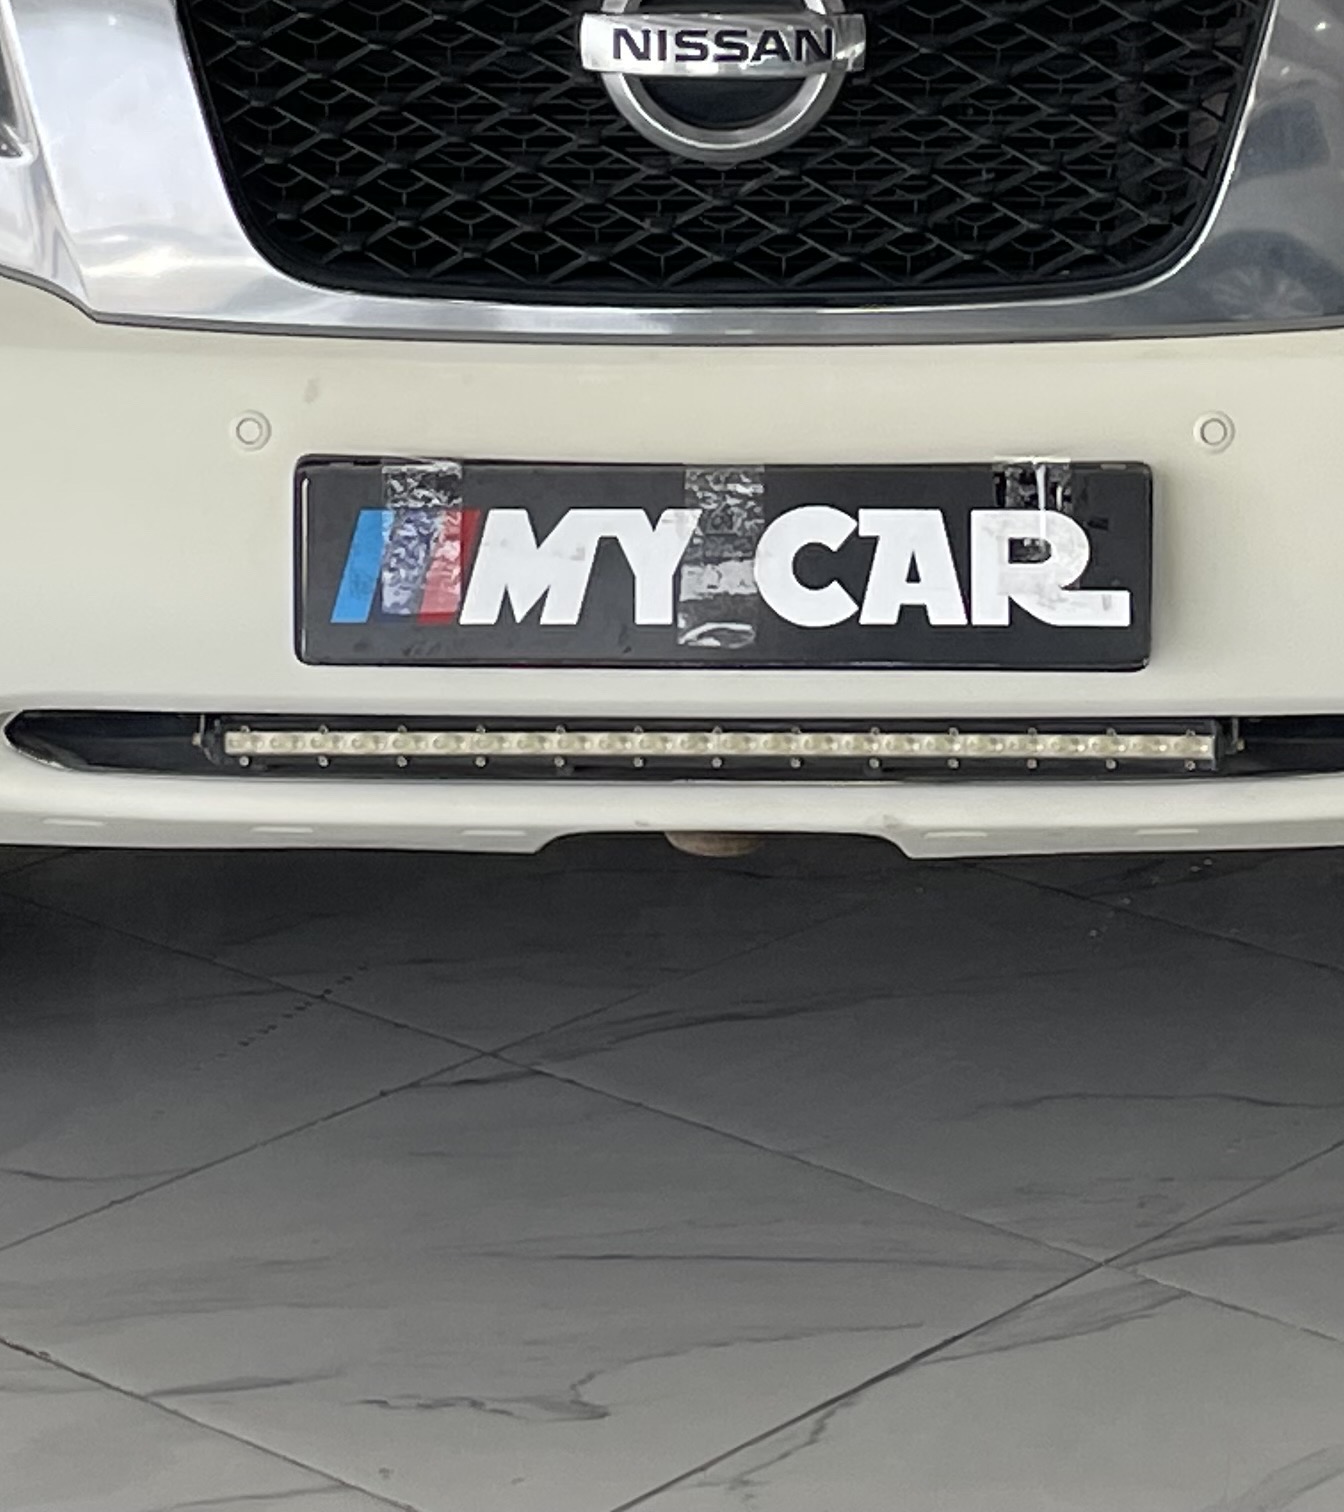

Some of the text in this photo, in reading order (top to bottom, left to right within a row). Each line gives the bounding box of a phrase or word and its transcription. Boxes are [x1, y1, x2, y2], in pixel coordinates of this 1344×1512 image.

[612, 27, 834, 63] NISSAN
[459, 504, 1132, 629] MY CAR
